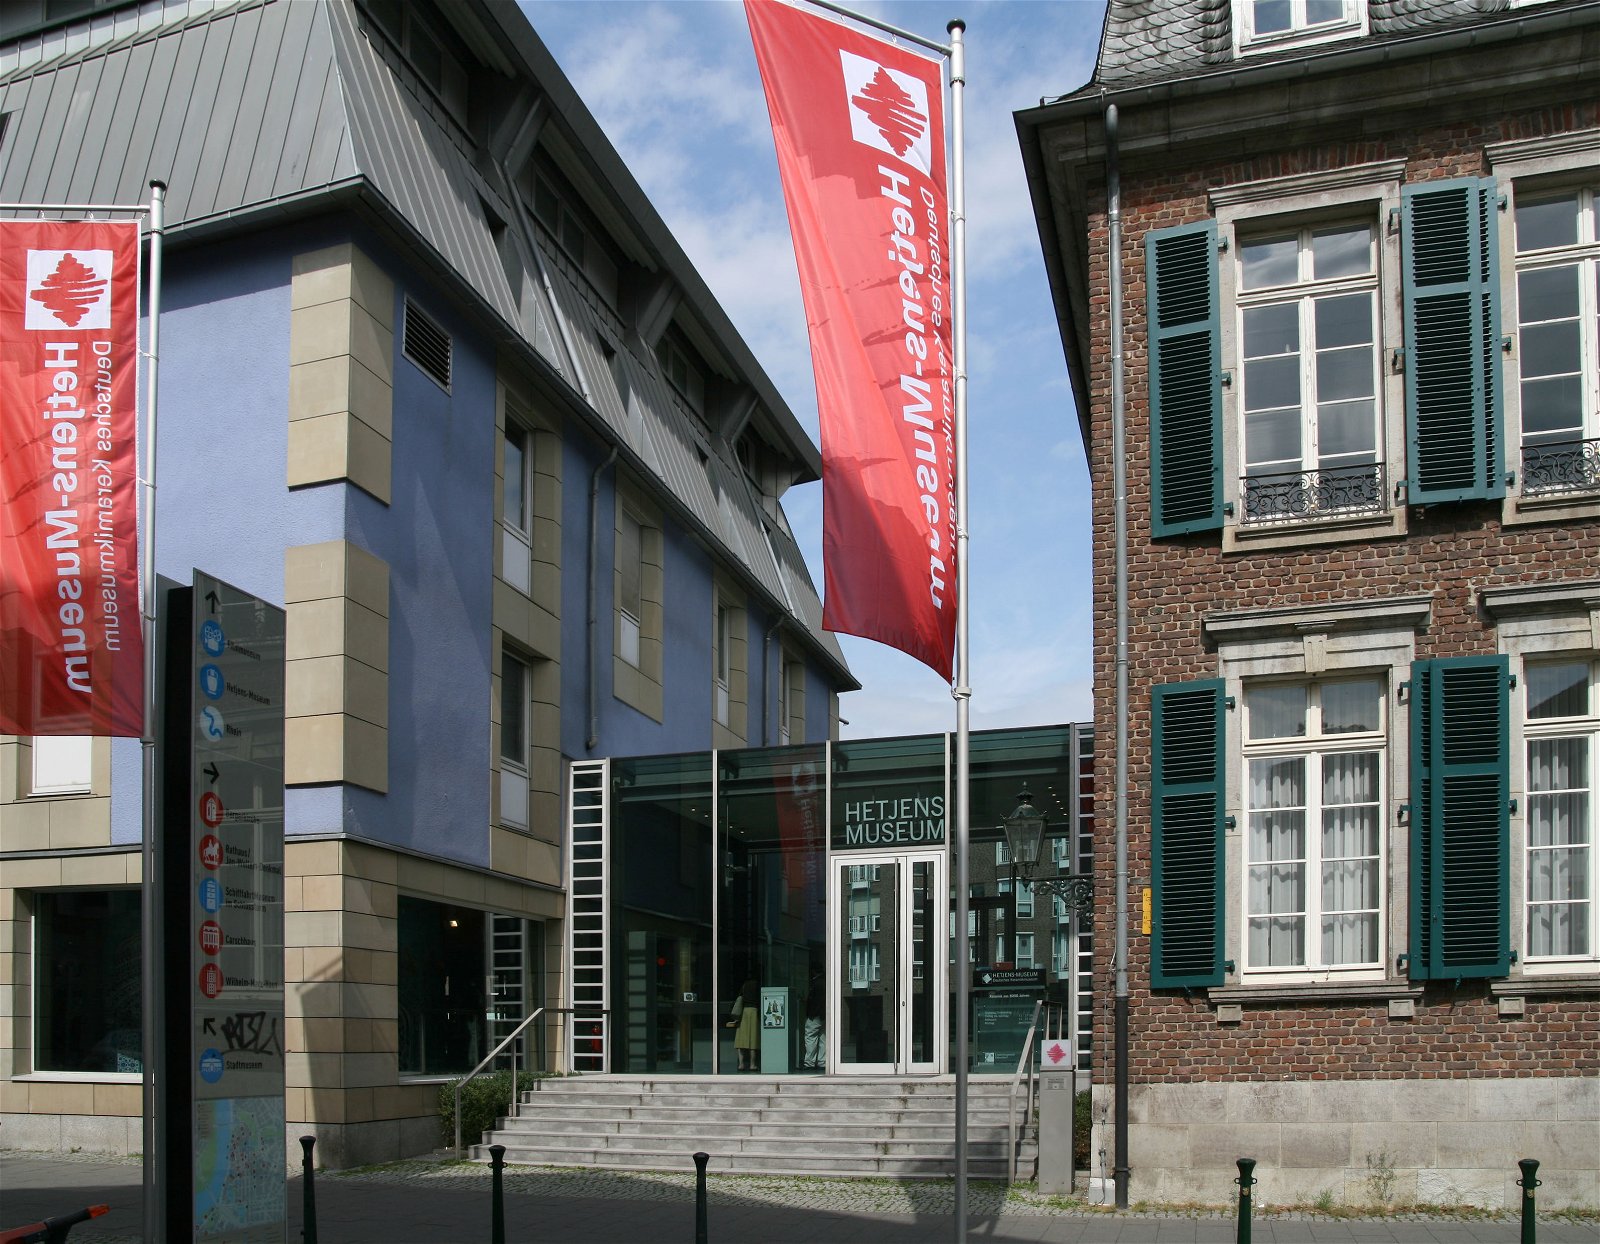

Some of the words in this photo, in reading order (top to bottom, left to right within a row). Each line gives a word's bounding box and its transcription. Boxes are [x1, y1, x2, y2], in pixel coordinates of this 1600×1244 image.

[226, 682, 271, 706] Hetjens-Museum
[845, 796, 944, 822] HETJENS
[846, 818, 944, 845] MUSEUM
[226, 976, 278, 989] Wilhelm-M-Haus
[226, 1060, 263, 1070] Stadtmuseum
